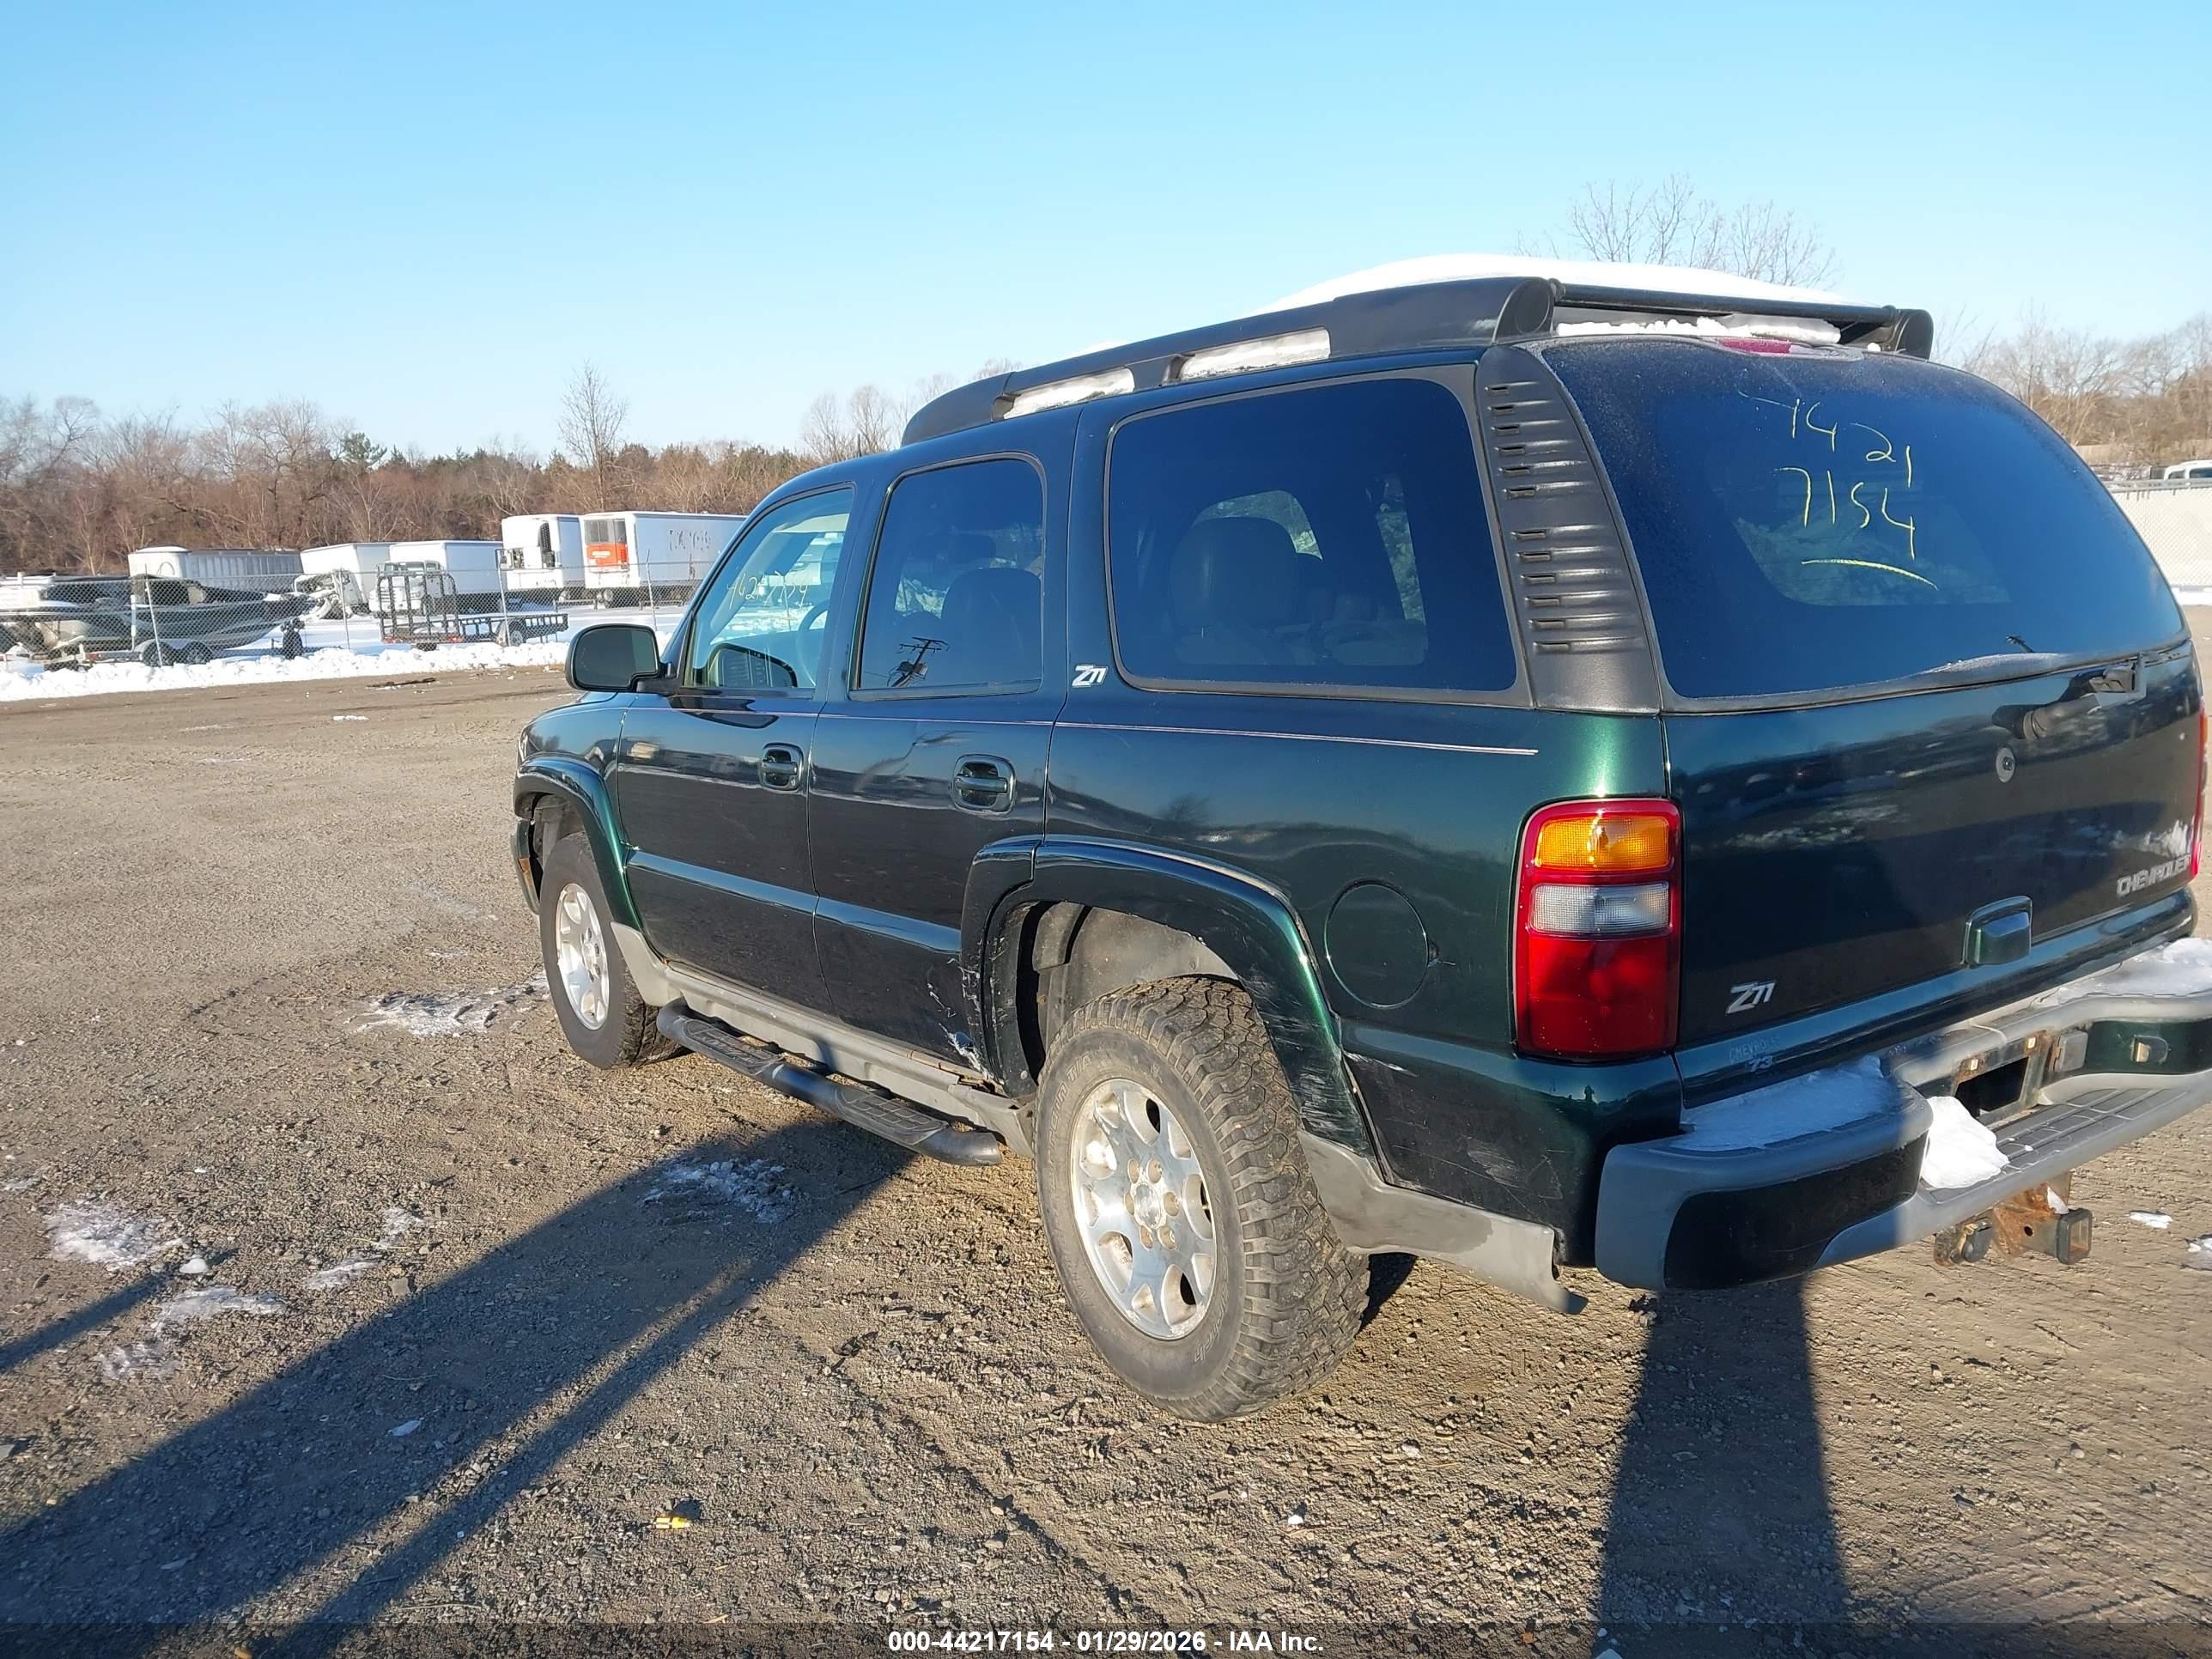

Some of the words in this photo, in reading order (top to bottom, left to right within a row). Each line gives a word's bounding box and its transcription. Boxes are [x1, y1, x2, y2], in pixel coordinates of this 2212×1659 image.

[1773, 467, 1917, 561] 7154
[1072, 663, 1109, 688] Z71
[1725, 979, 1776, 1017] Z71
